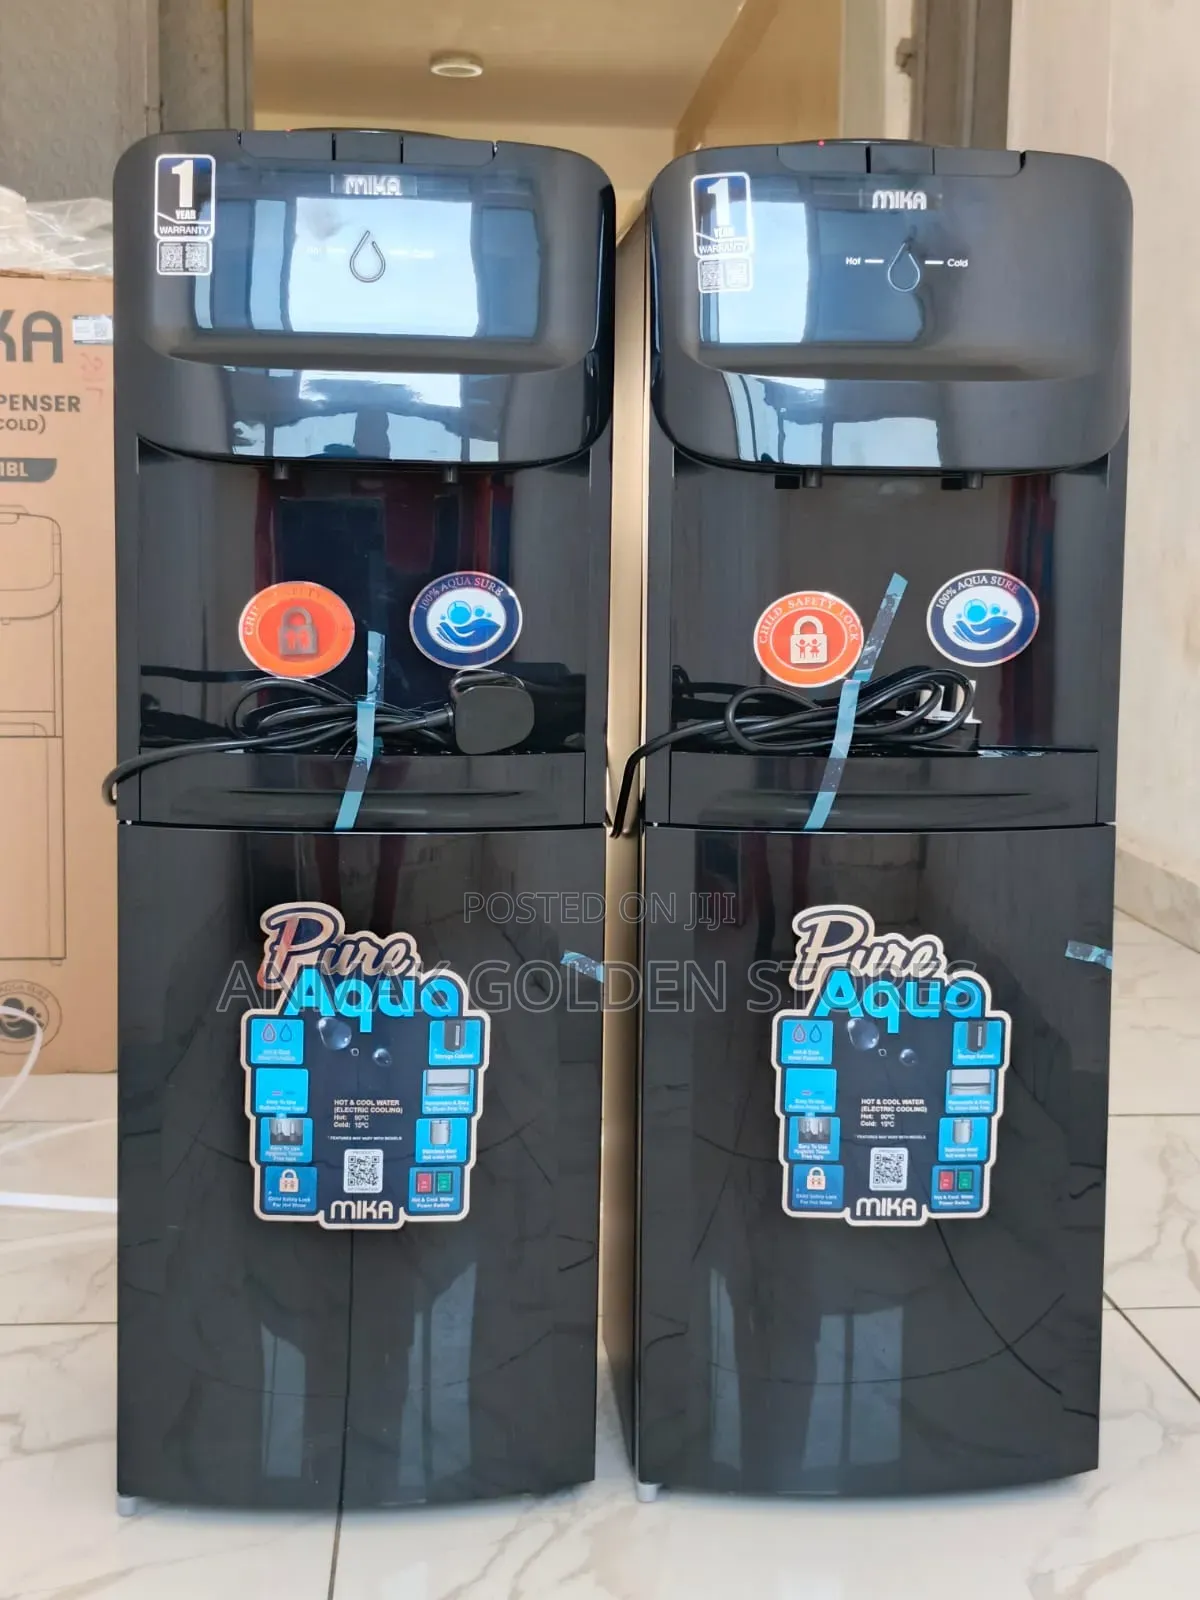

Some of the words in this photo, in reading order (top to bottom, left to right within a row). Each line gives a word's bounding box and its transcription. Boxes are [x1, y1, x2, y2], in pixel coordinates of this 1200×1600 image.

[171, 159, 194, 208] 1
[345, 175, 403, 196] MIKA
[707, 178, 730, 227] 1
[872, 190, 927, 210] MIKA
[175, 210, 196, 220] YEAR
[160, 226, 209, 235] WARRANTY
[845, 257, 861, 266] Hot
[947, 258, 968, 267] Cold
[419, 587, 440, 611] 100%
[440, 577, 472, 592] AQUA
[474, 578, 504, 596] SURE
[936, 586, 957, 610] 100%
[958, 575, 988, 590] AQUA
[990, 576, 1020, 595] SURE
[759, 606, 784, 644] CHILD
[787, 596, 837, 609] SAFETY
[840, 607, 860, 642] LOCK
[261, 905, 417, 985] Pure
[795, 909, 940, 986] Pure
[283, 968, 460, 1033] Aqua
[813, 970, 982, 1034] Aqua
[334, 1106, 369, 1114] (ELECTRIC
[861, 1105, 895, 1113] (ELECTRIC
[895, 1106, 928, 1114] COOLING)
[330, 1200, 394, 1219] MIKA
[855, 1197, 917, 1217] MIKA
